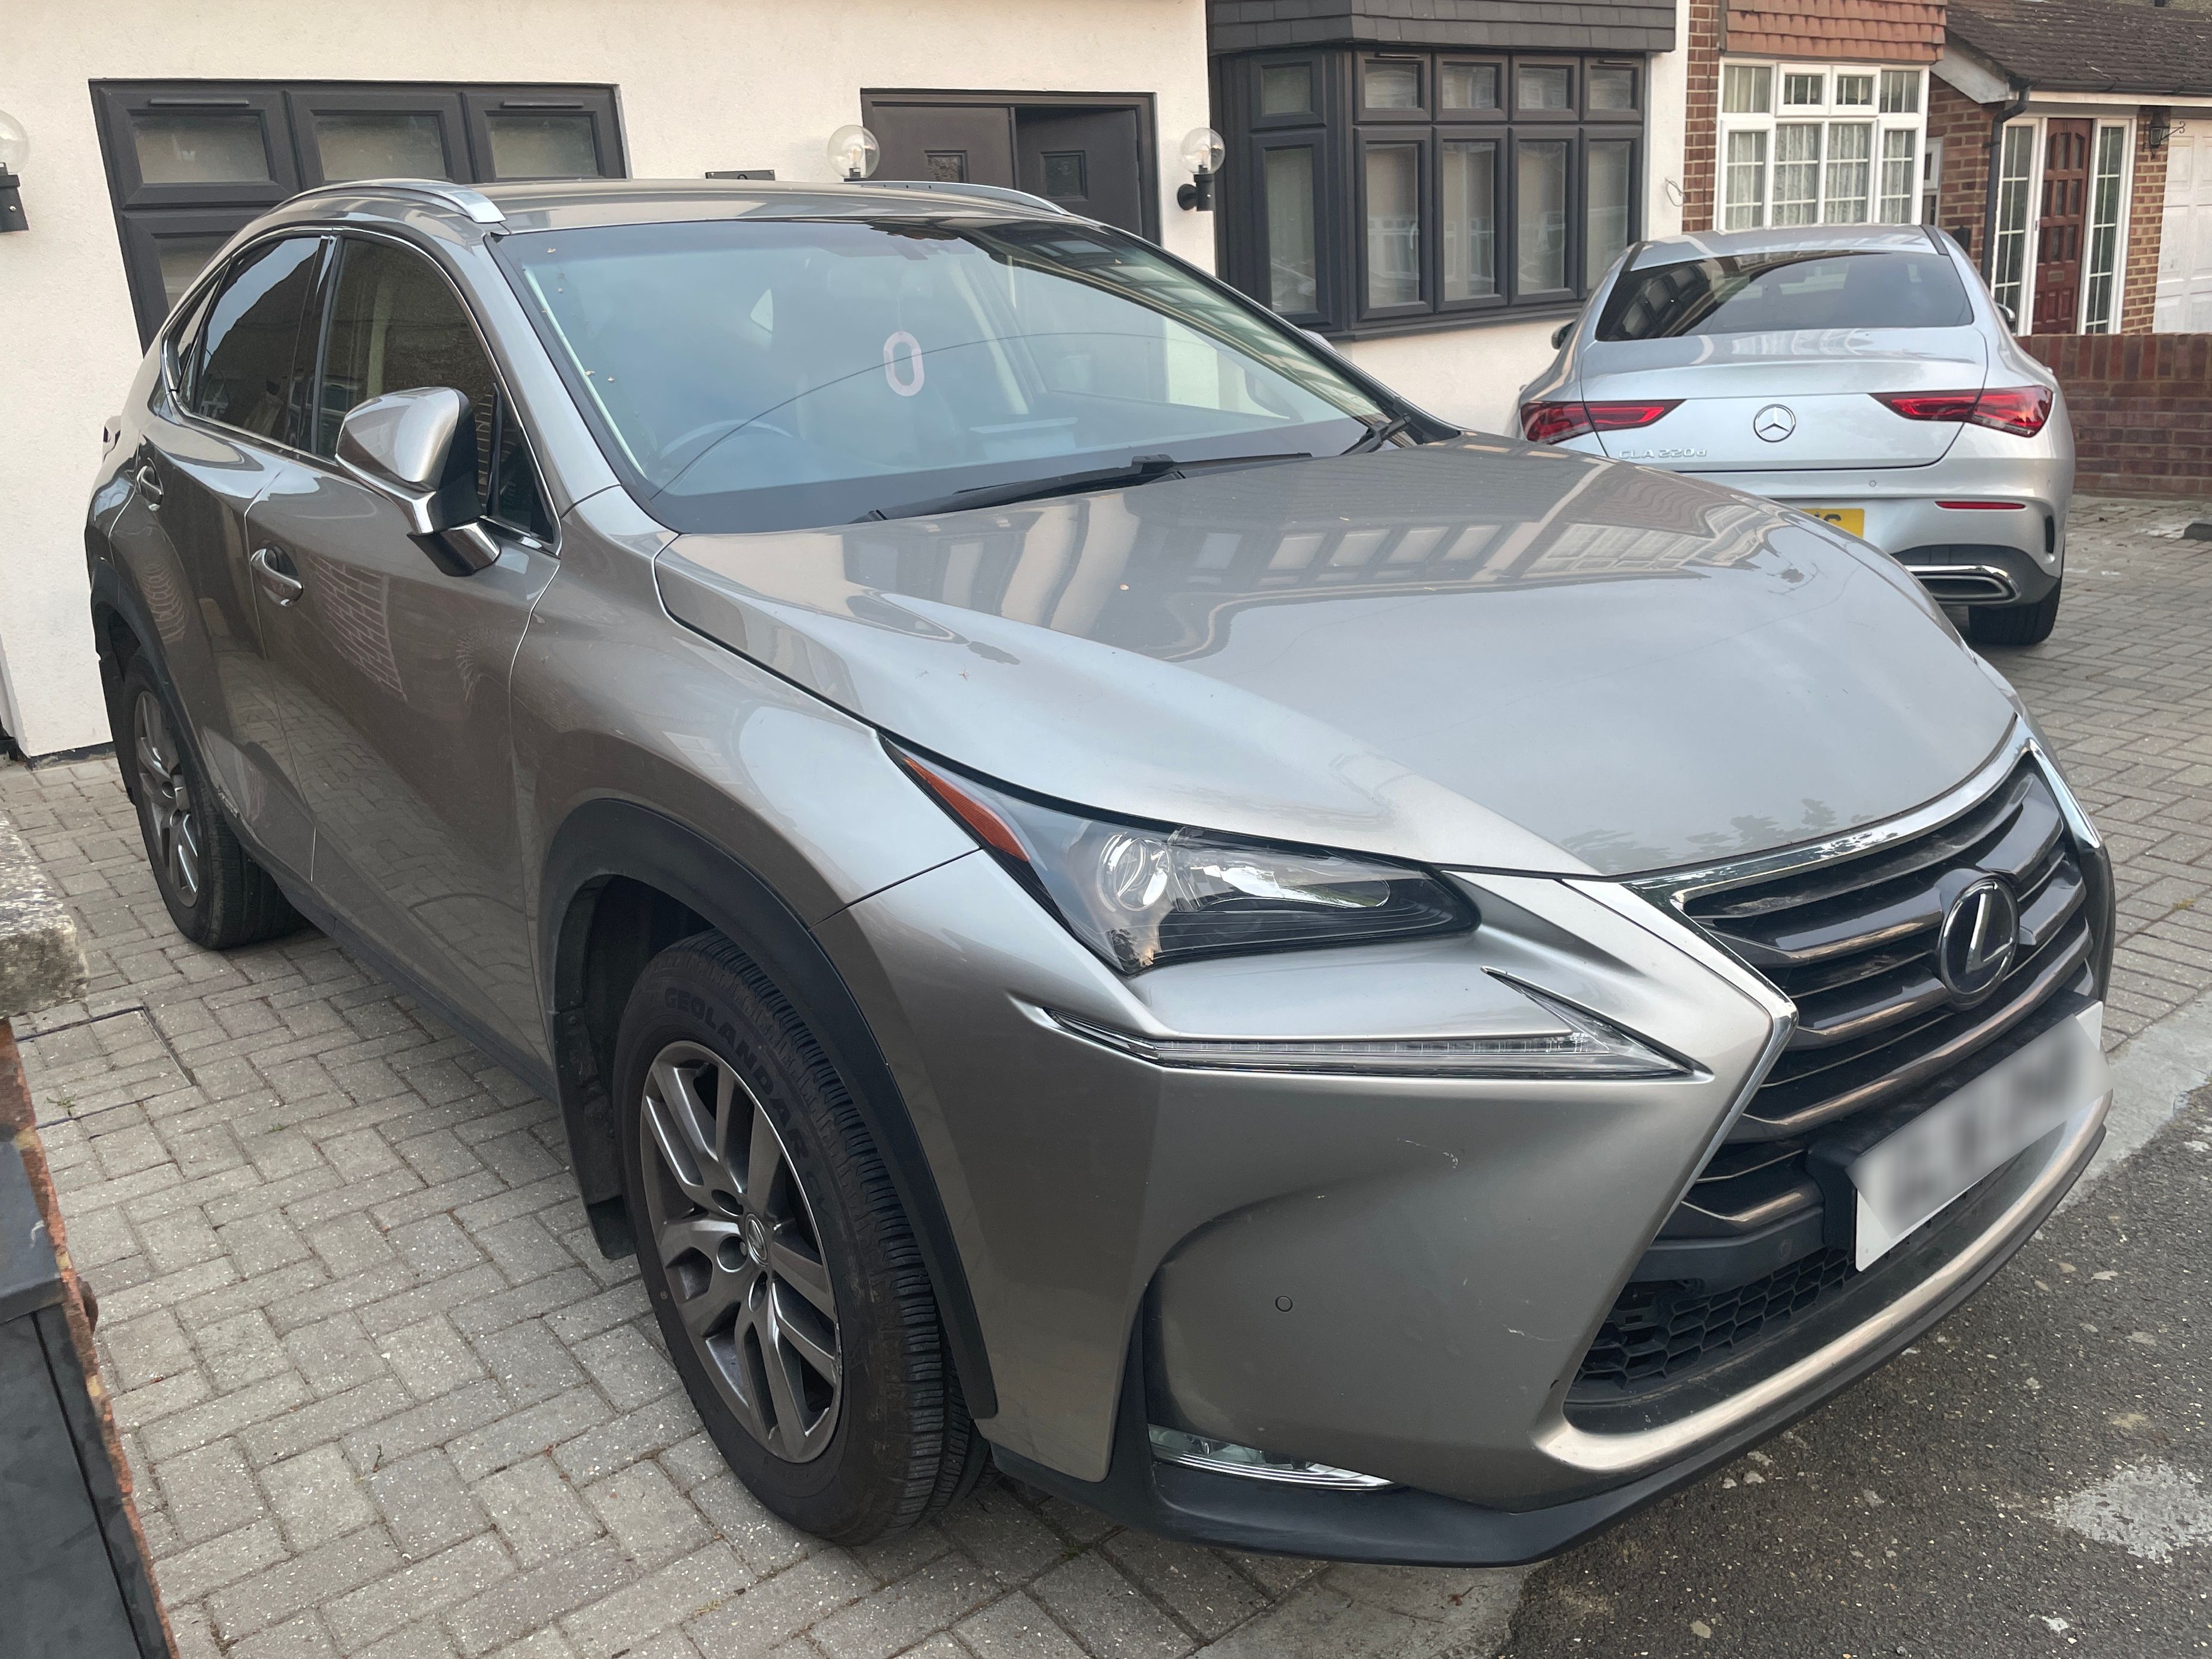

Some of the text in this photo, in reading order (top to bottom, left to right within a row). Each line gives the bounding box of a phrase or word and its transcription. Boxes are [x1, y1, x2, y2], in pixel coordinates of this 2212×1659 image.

[1619, 448, 1707, 459] CLA 220d
[664, 987, 809, 1159] GEOLANDAR
